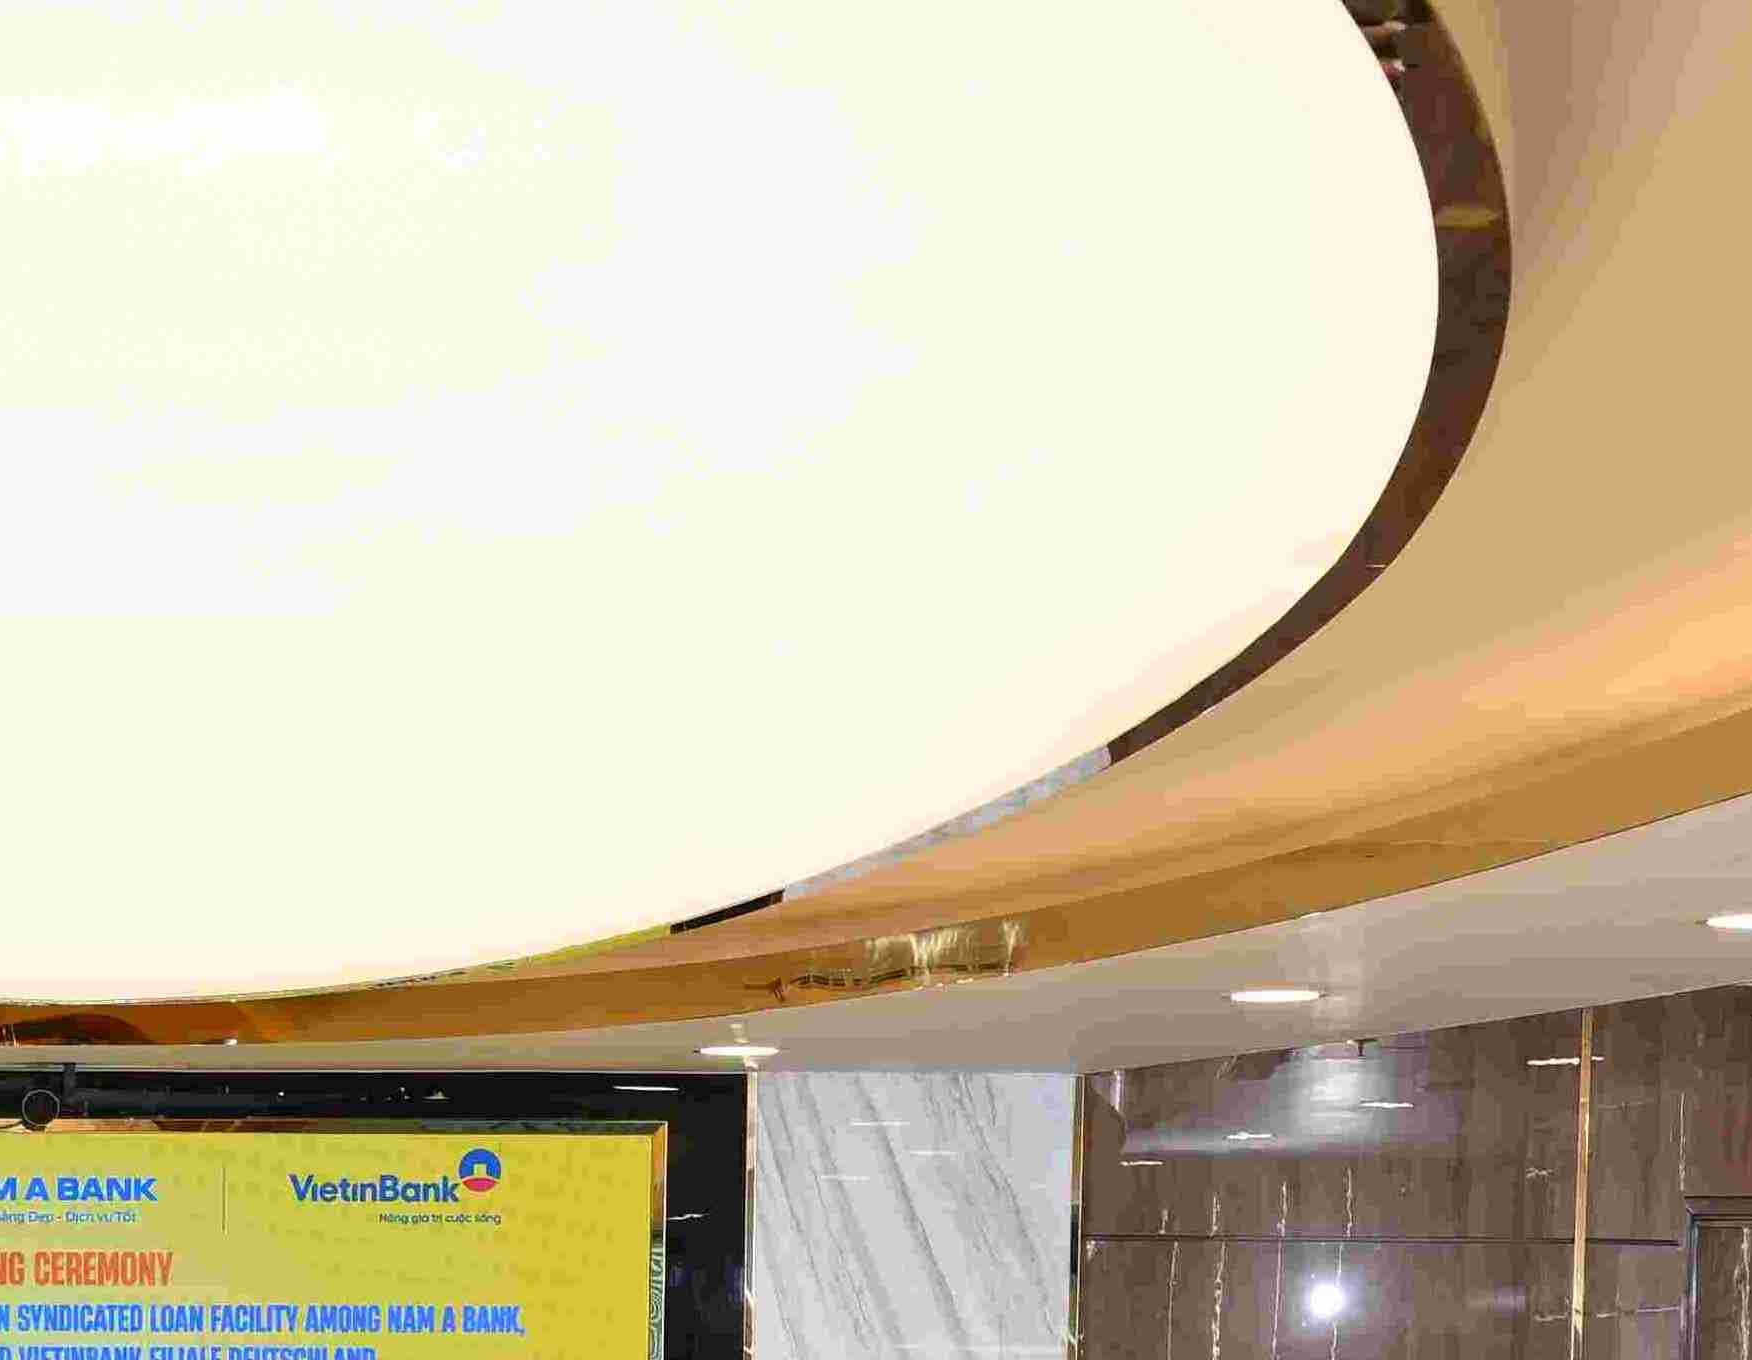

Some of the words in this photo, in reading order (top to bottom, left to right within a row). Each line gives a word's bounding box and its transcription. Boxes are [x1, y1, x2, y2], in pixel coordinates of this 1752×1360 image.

[24, 1176, 51, 1201] A
[57, 1176, 159, 1201] BANK
[288, 1174, 460, 1203] VietinBank
[34, 1250, 174, 1288] CEREMONY
[16, 1303, 144, 1334] SYNDICATED
[149, 1303, 205, 1334] LOAN
[211, 1304, 298, 1334] FACILITY
[305, 1303, 382, 1334] AMONG
[387, 1303, 435, 1334] NAM
[441, 1303, 456, 1334] A
[462, 1303, 526, 1337] BANK,
